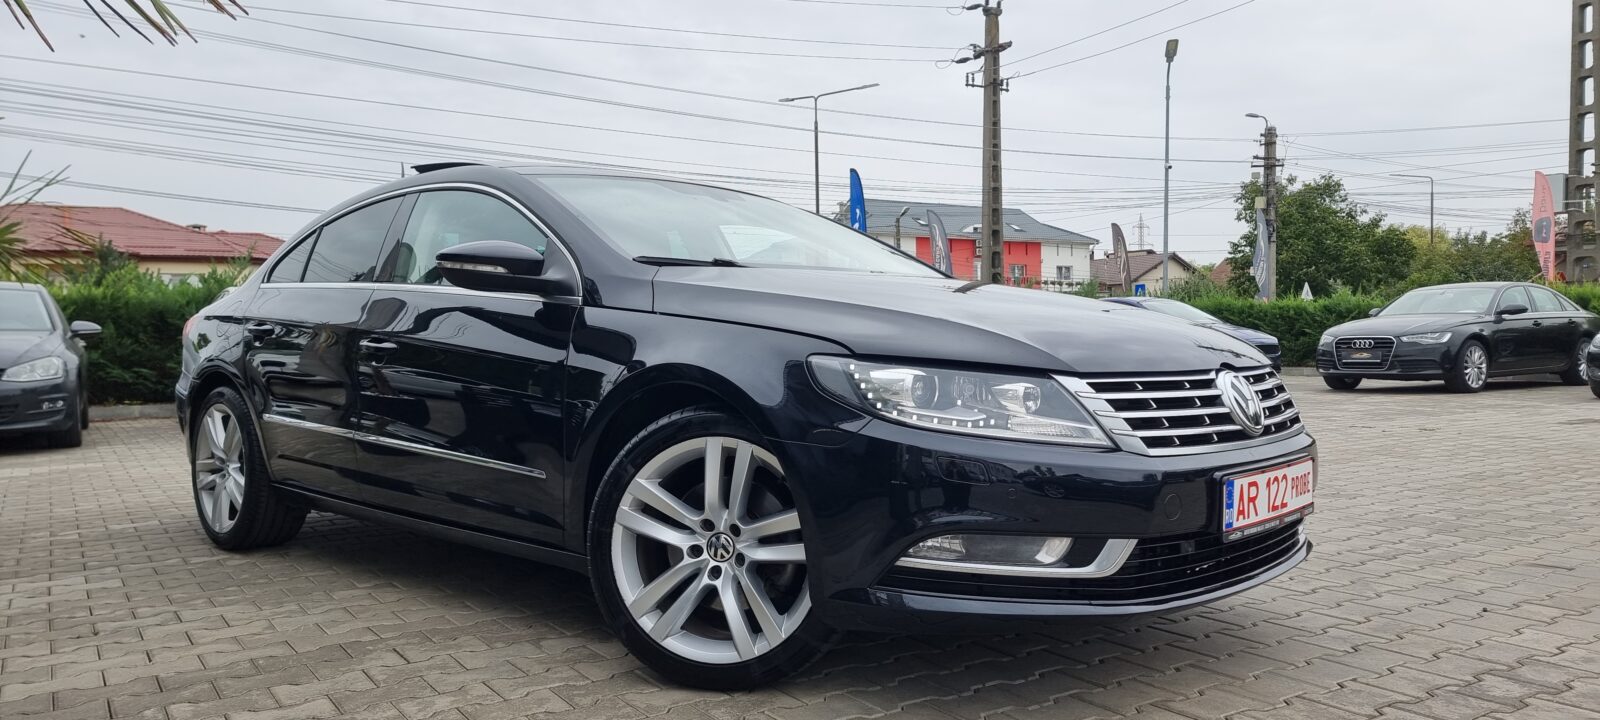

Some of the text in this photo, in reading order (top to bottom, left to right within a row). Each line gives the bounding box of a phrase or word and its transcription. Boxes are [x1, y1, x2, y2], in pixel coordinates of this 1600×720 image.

[1236, 480, 1260, 522] AR
[1266, 473, 1289, 514] 122
[1291, 471, 1311, 499] PROBE
[1225, 508, 1234, 524] RO
